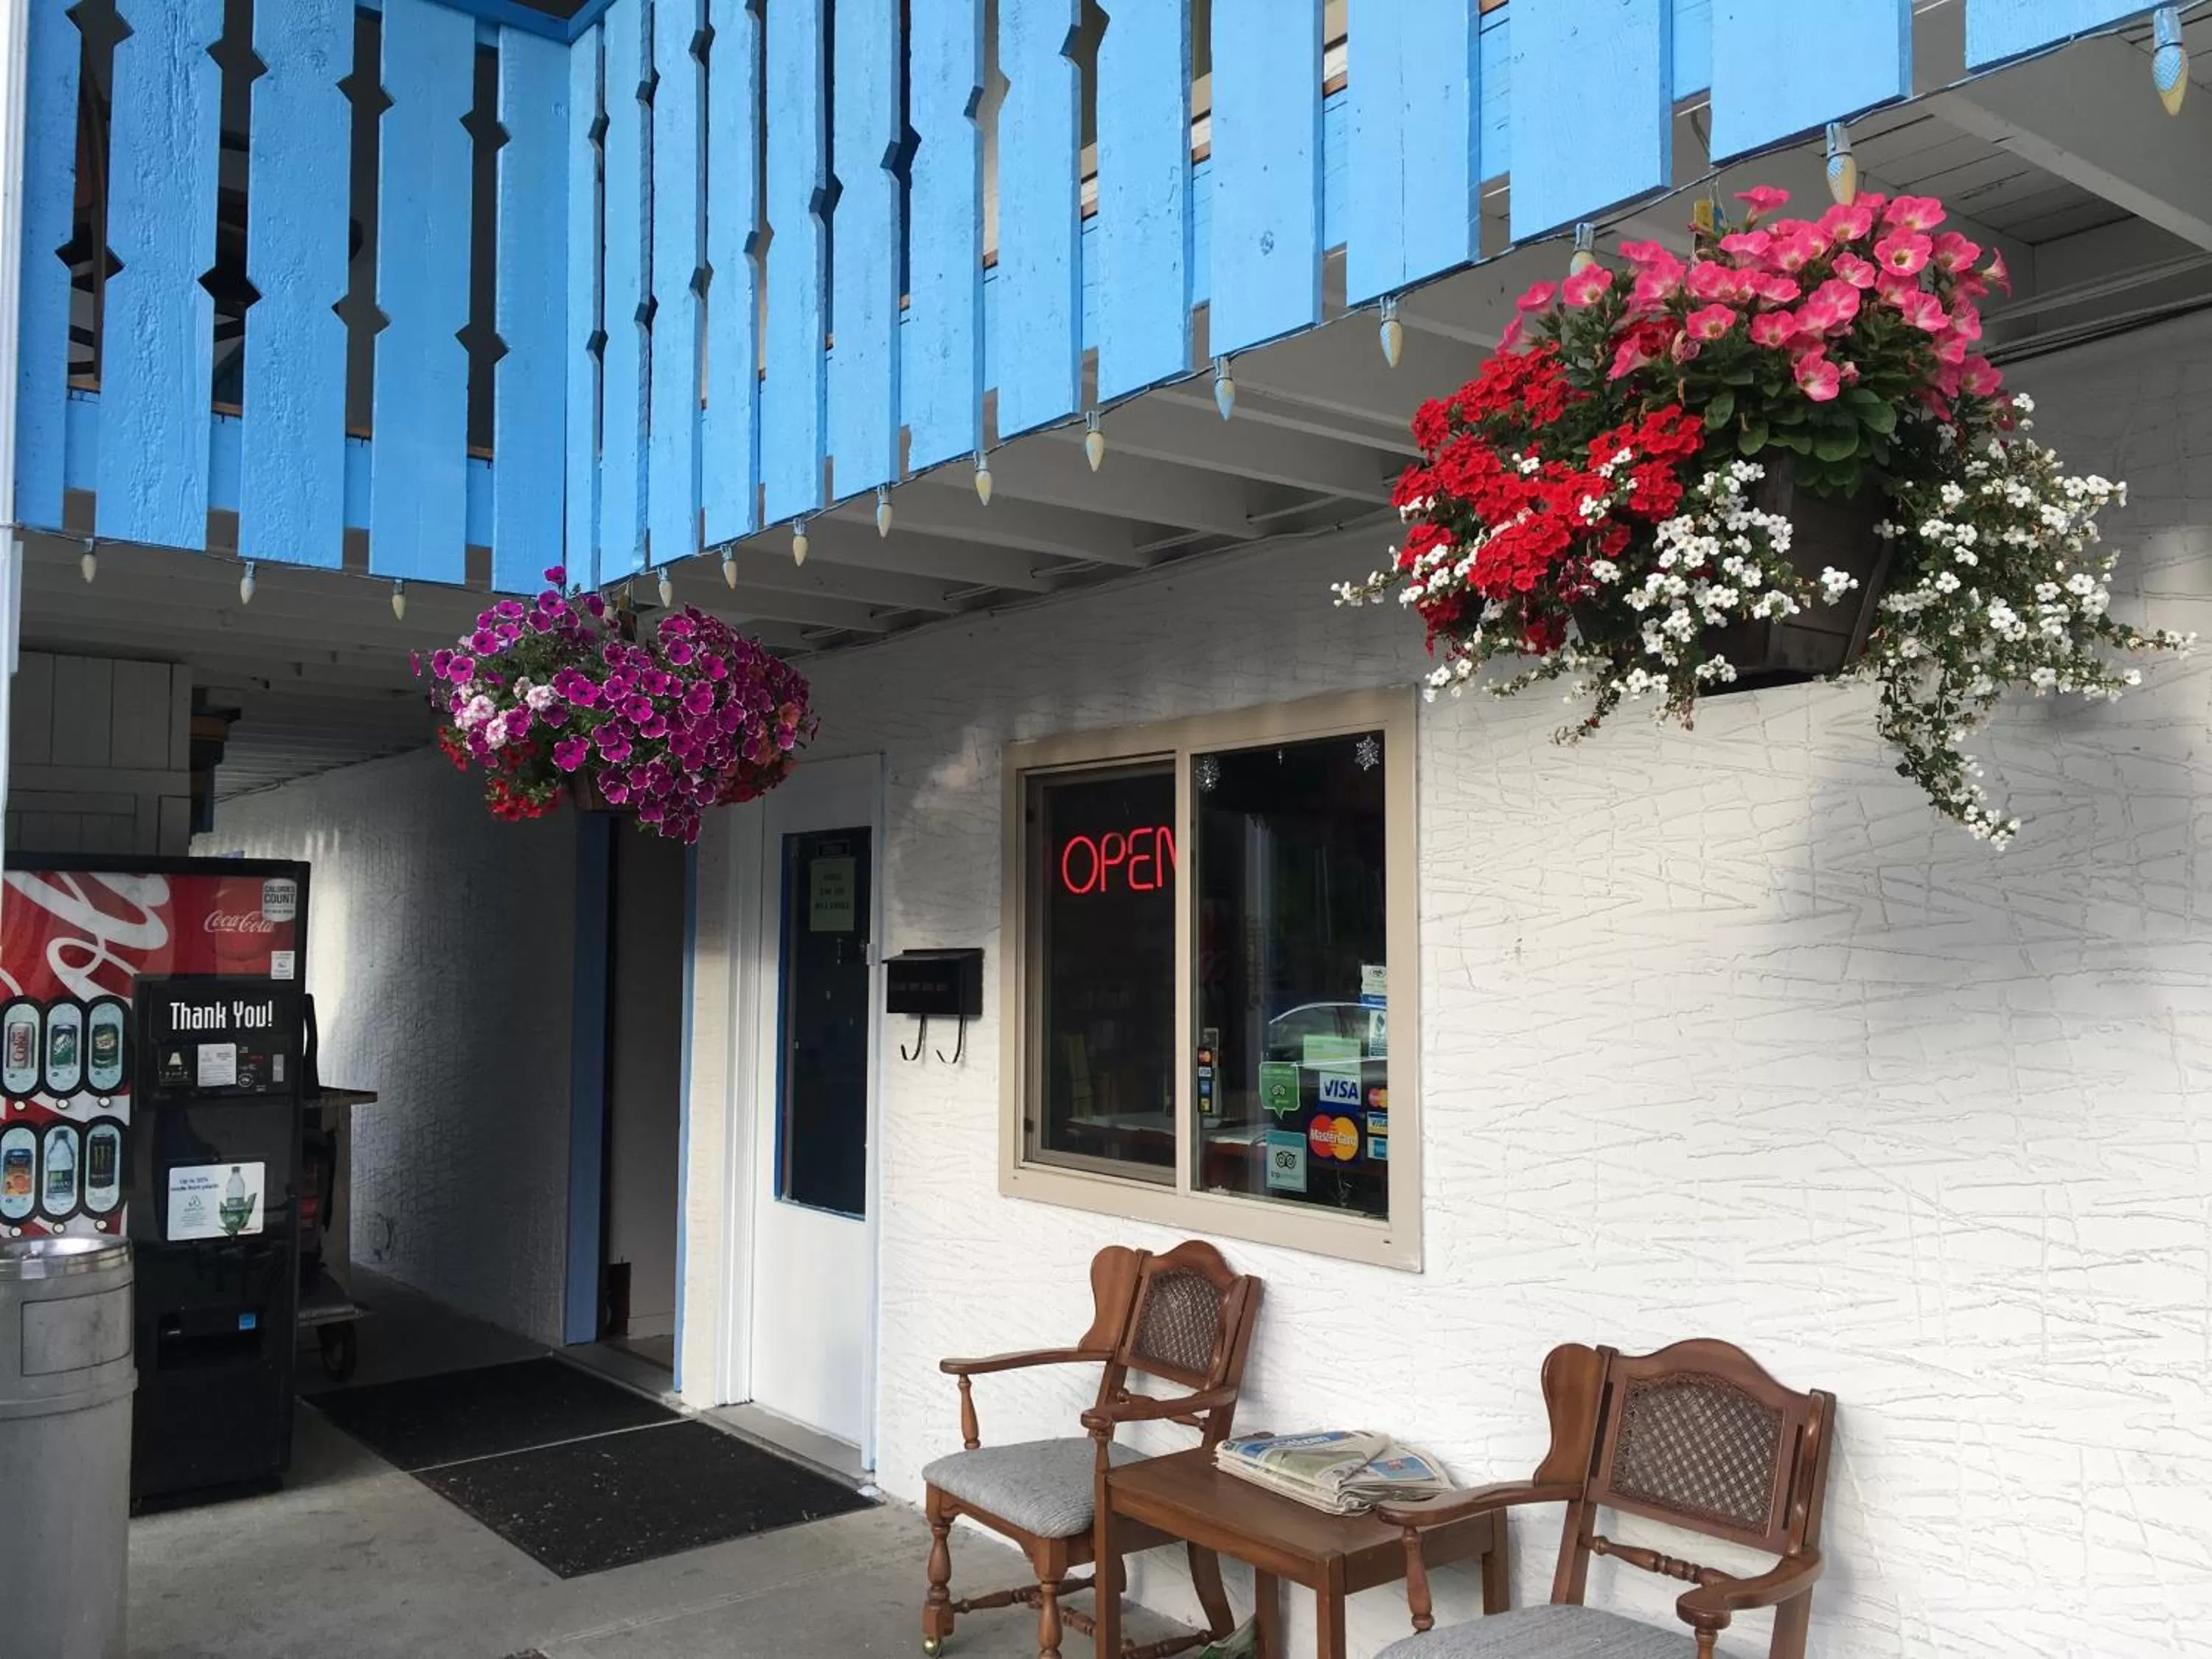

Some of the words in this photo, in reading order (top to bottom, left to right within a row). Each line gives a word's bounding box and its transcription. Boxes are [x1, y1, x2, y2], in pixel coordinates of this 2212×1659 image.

[264, 893, 295, 904] COUNT
[170, 1001, 226, 1030] Thank
[233, 1001, 273, 1028] You!
[1324, 1079, 1359, 1100] VISA
